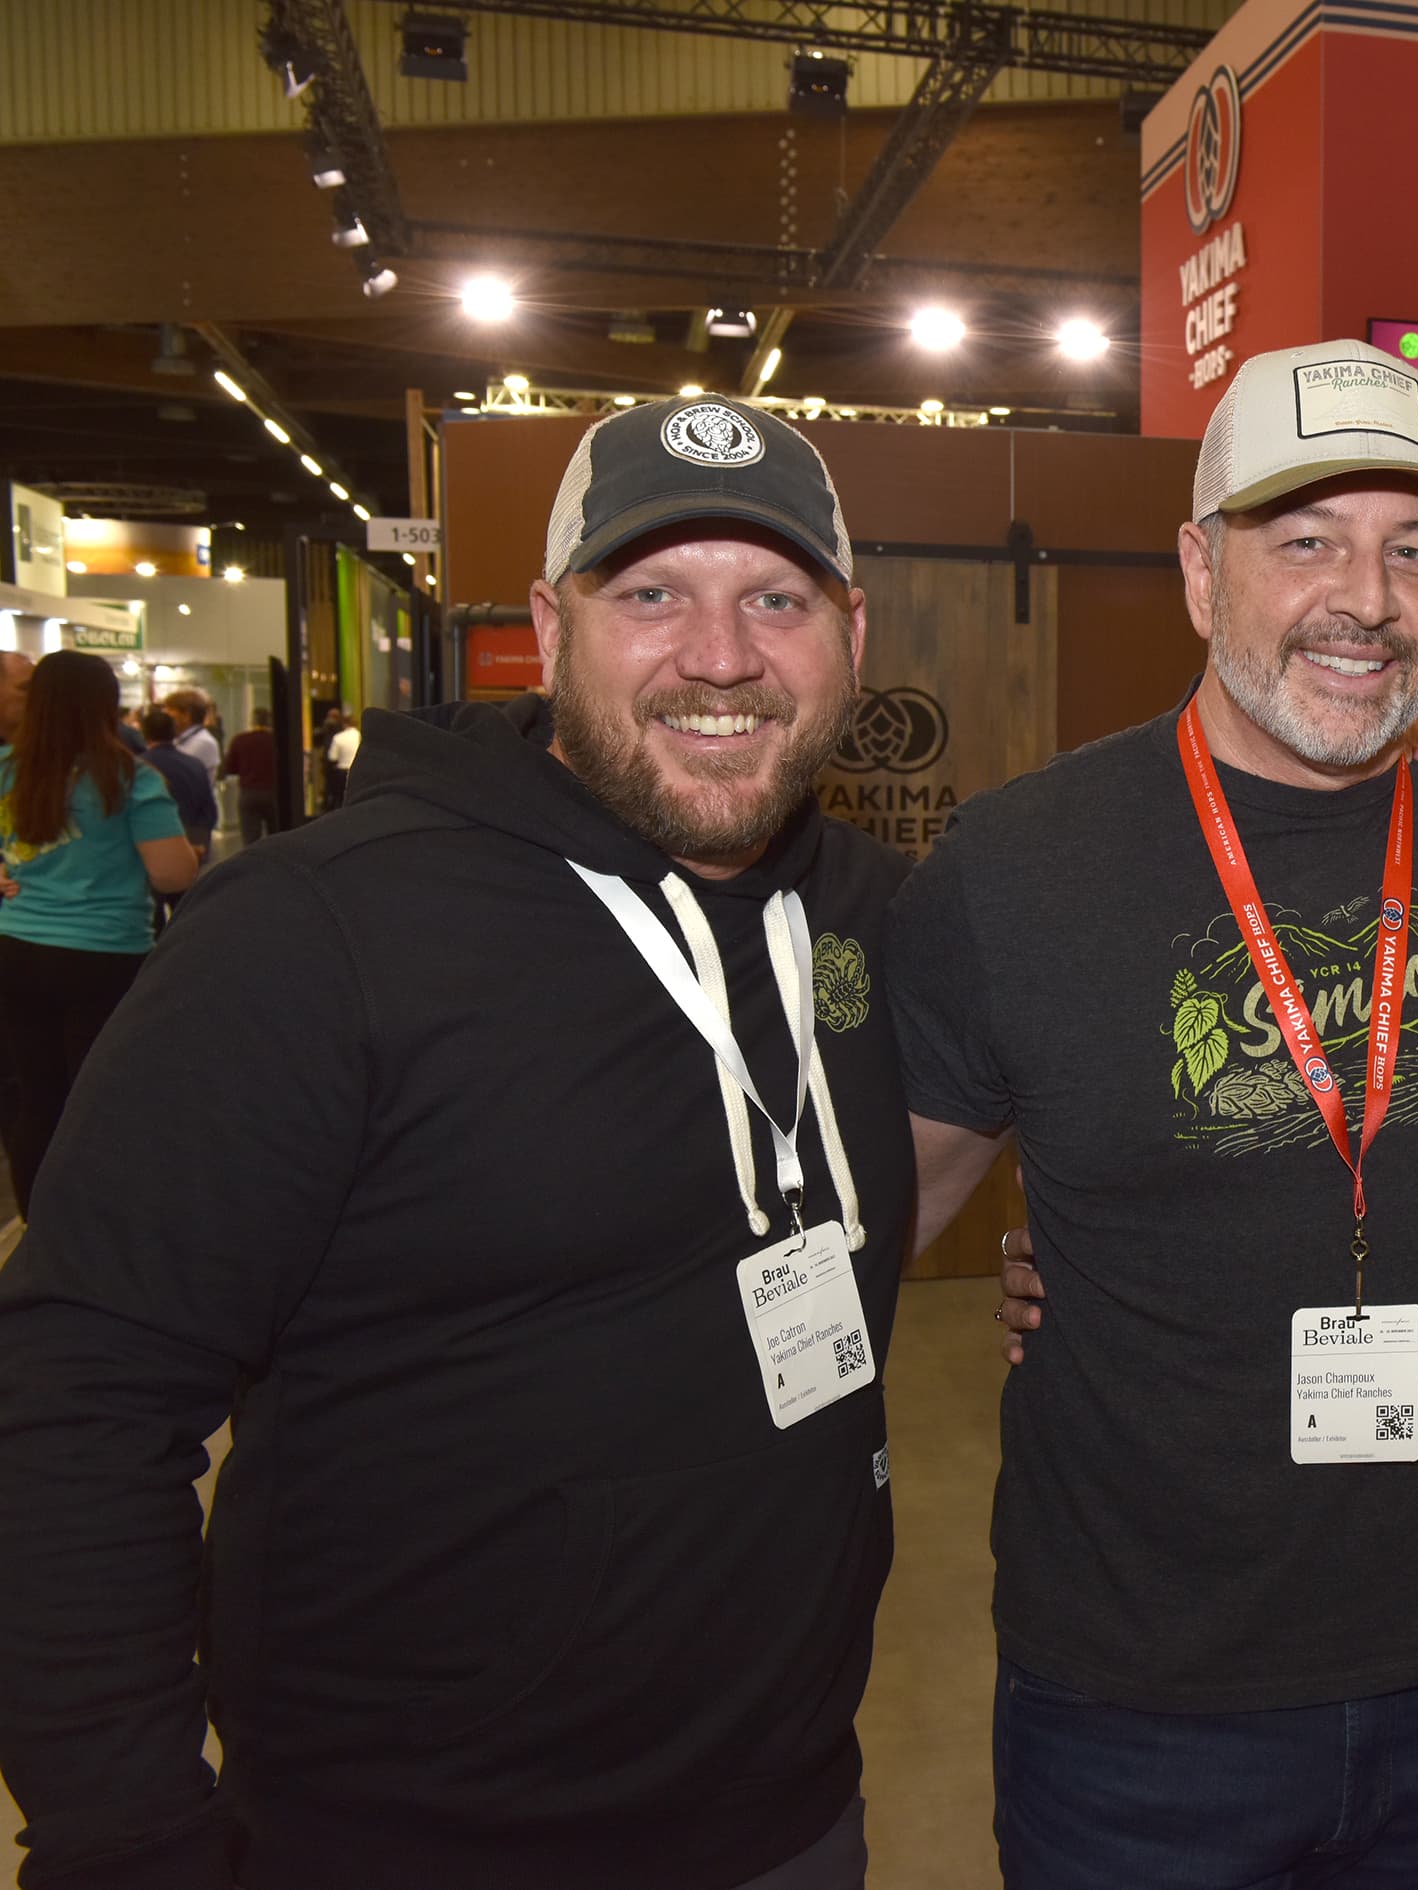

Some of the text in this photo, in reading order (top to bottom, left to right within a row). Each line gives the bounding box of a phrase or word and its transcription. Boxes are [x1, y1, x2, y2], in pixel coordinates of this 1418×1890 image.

[1179, 222, 1246, 306] YAKIMA
[1185, 282, 1239, 355] CHIEF
[1303, 365, 1365, 383] YAKIMA
[1371, 368, 1413, 392] CHIEF
[1331, 375, 1388, 392] Ranches
[670, 422, 682, 441] HOP
[684, 406, 721, 417] BREW
[722, 410, 756, 443] SCHOOL
[682, 445, 750, 460] SINCE 2004
[1206, 791, 1218, 815] HOPS
[1215, 816, 1237, 866] AMERICAN
[1243, 903, 1313, 1054] YAKIMA CHIEF HOPS
[1310, 961, 1361, 980] YCR 14
[1375, 936, 1397, 1091] YAKIMA CHIEF HOPS
[761, 1263, 790, 1285] Brau
[753, 1270, 809, 1309] Beviale
[767, 1320, 807, 1350] Joe Catron
[1320, 1316, 1356, 1330] Brau
[771, 1321, 844, 1366] Yakima Chief Ranches
[1303, 1328, 1374, 1346] Beviale
[777, 1373, 785, 1389] A
[1297, 1372, 1375, 1385] Jason Champoux
[1297, 1387, 1393, 1400] Yakima Chief Ranches
[1307, 1414, 1317, 1428] A
